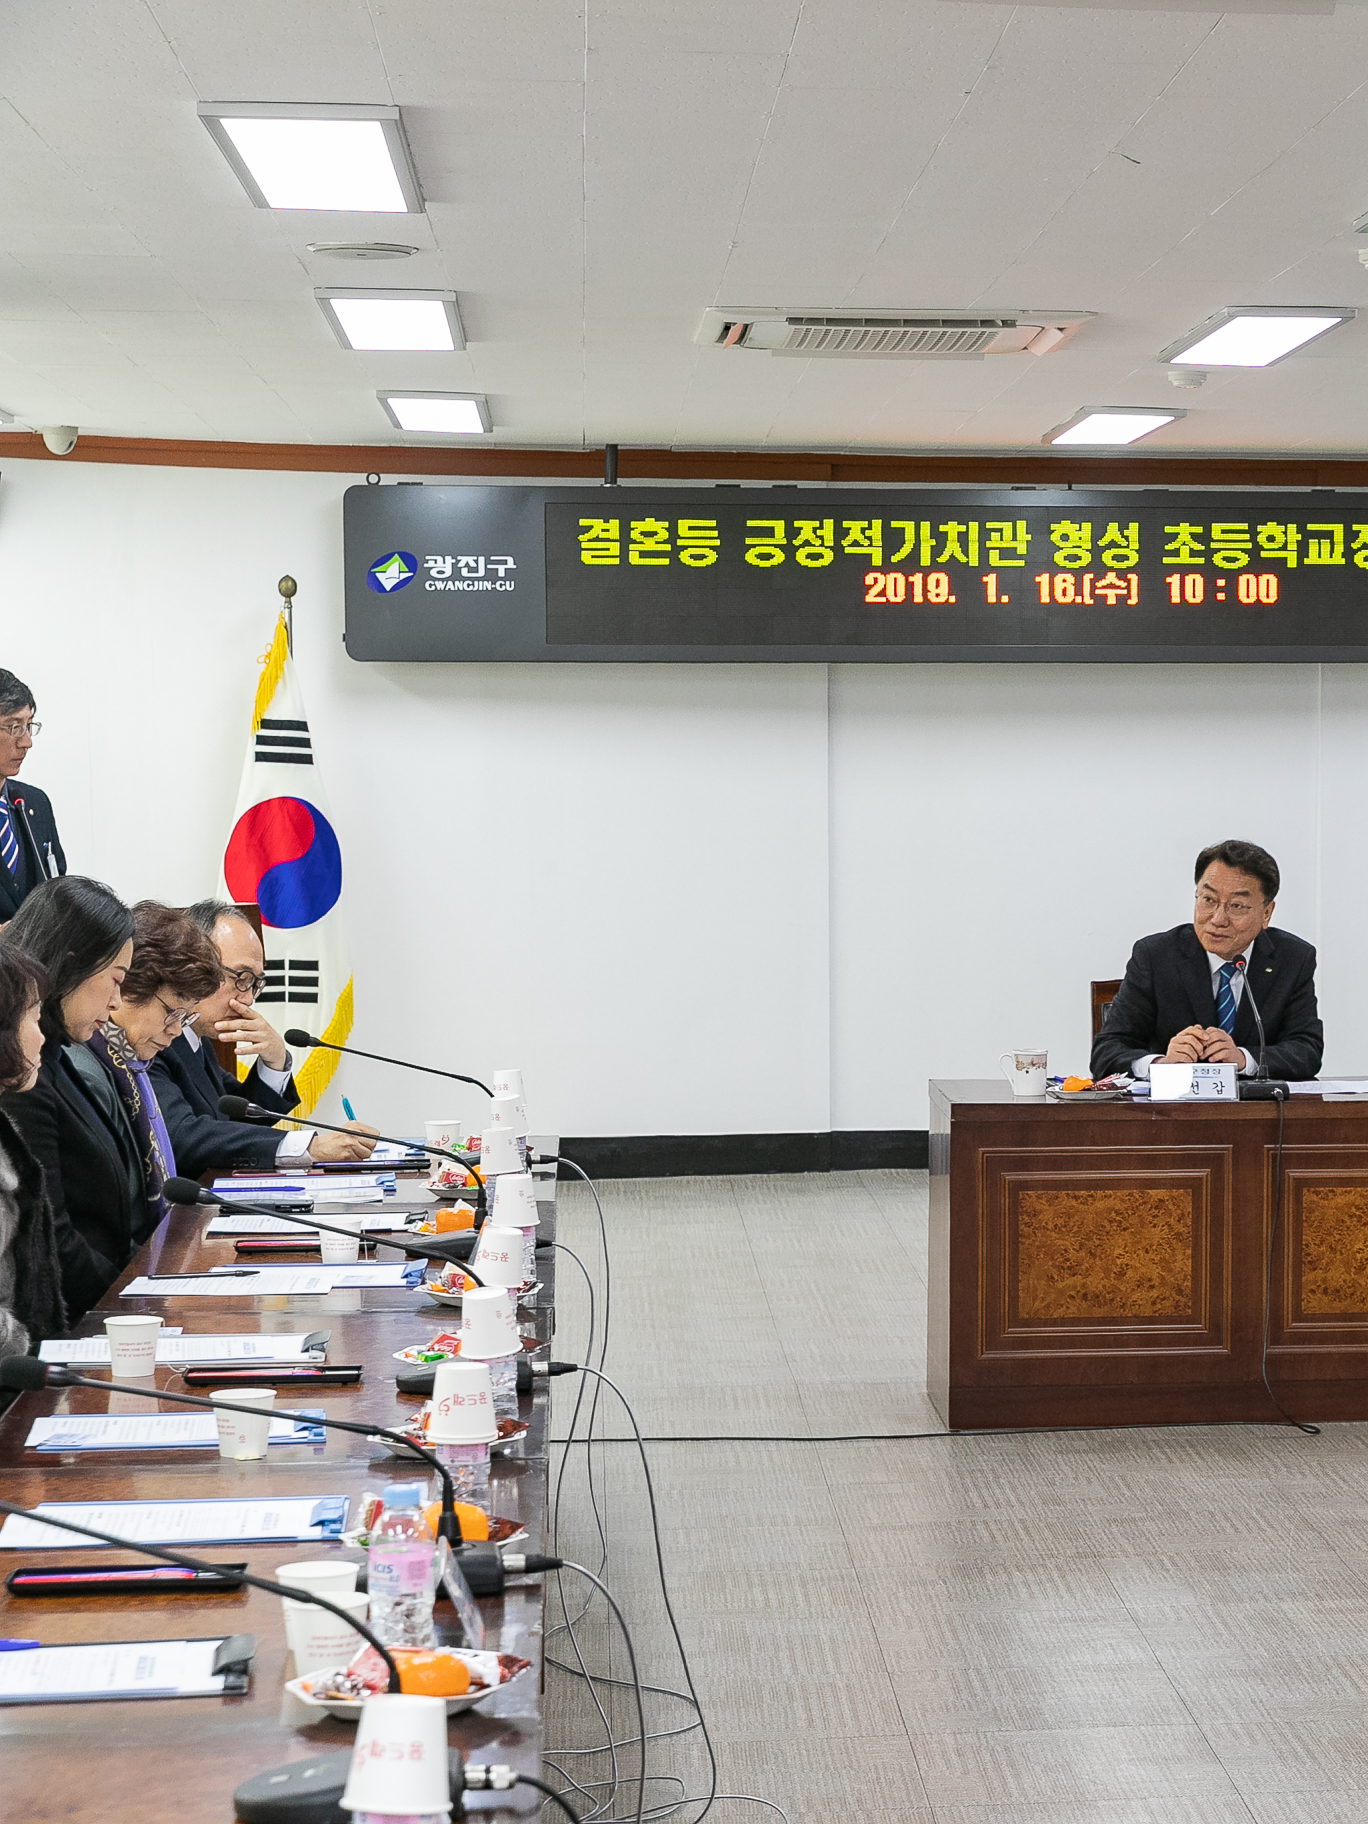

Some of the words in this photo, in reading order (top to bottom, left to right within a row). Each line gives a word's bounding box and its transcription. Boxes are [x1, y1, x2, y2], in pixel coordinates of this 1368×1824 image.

[577, 517, 721, 568] 결혼등
[744, 518, 1031, 569] 긍정적가치관
[1050, 520, 1140, 570] 형성
[423, 554, 518, 579] 광진구
[424, 579, 517, 592] GWANGJIN-GU
[864, 571, 957, 605] 2019.
[982, 572, 1010, 604] 1.
